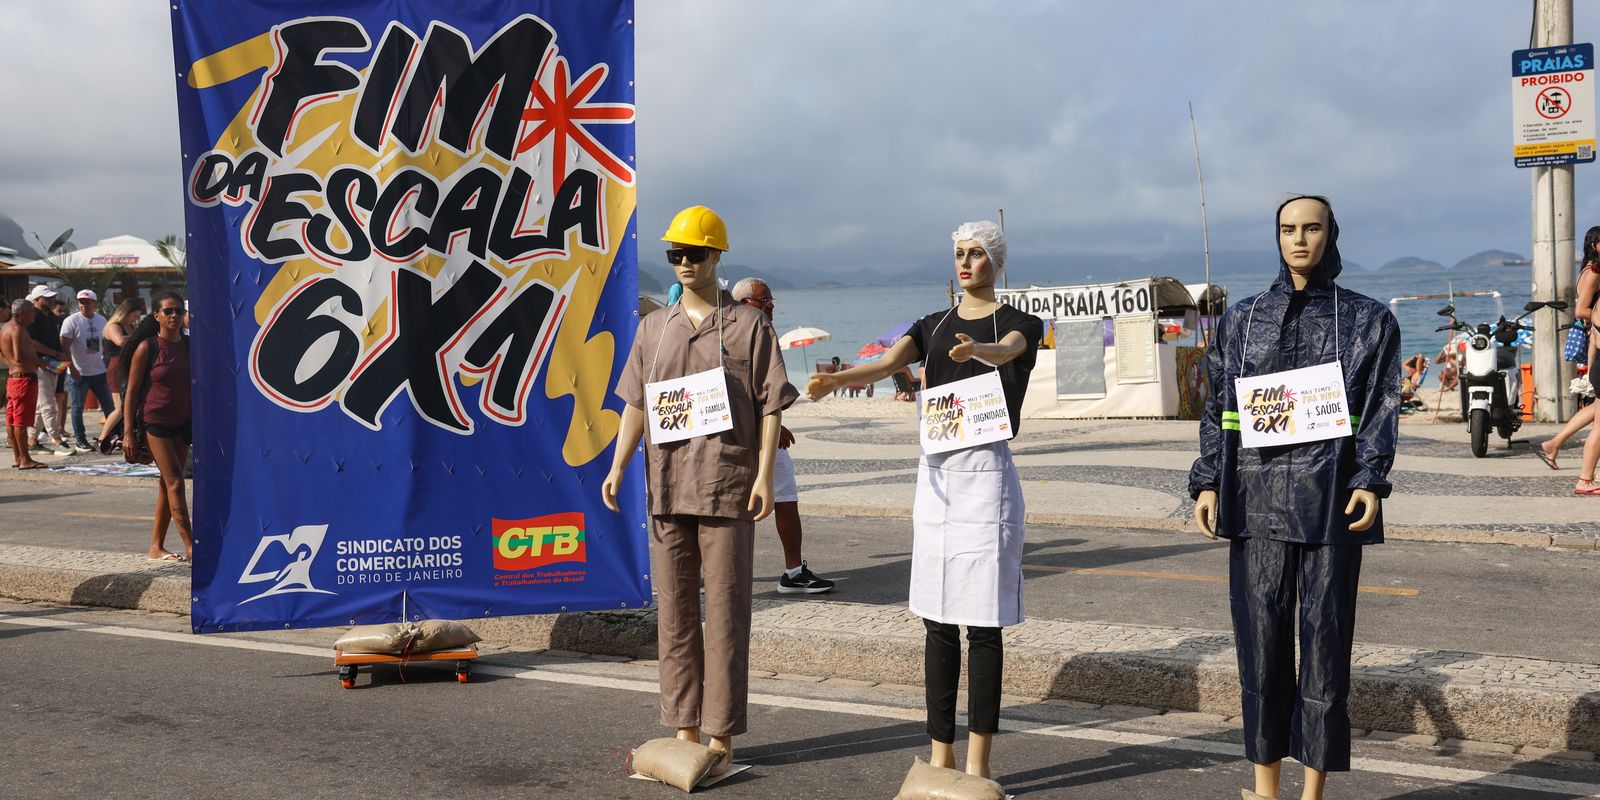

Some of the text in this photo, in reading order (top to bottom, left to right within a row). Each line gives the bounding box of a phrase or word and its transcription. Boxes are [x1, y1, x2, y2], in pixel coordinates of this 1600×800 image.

[1521, 54, 1585, 74] PRAIAS
[254, 16, 555, 162] FIM
[1521, 72, 1585, 87] PROIBIDO
[193, 151, 607, 263] DA ESCALA
[1032, 298, 1050, 313] DA
[1053, 291, 1108, 317] PRAIA
[1111, 287, 1149, 314] 160
[254, 260, 563, 432] 6X1
[659, 387, 686, 405] FIM
[927, 392, 955, 413] FIM
[1251, 384, 1286, 404] FIM
[658, 401, 692, 416] ESCALA
[705, 402, 726, 415] FAMÍLIA
[926, 408, 963, 425] ESCALA
[973, 408, 1007, 423] DIGNIDADE
[1251, 401, 1295, 416] ESCALA
[1316, 402, 1342, 416] SAÚDE
[660, 413, 688, 430] 6X1
[928, 421, 959, 441] 6X1
[1253, 414, 1289, 434] 6X1
[336, 536, 462, 555] SINDICATO DOS
[498, 525, 580, 559] CTB
[336, 552, 463, 572] COMERCIÁRIOS
[337, 568, 463, 584] DO RIO DE JANEIRO
